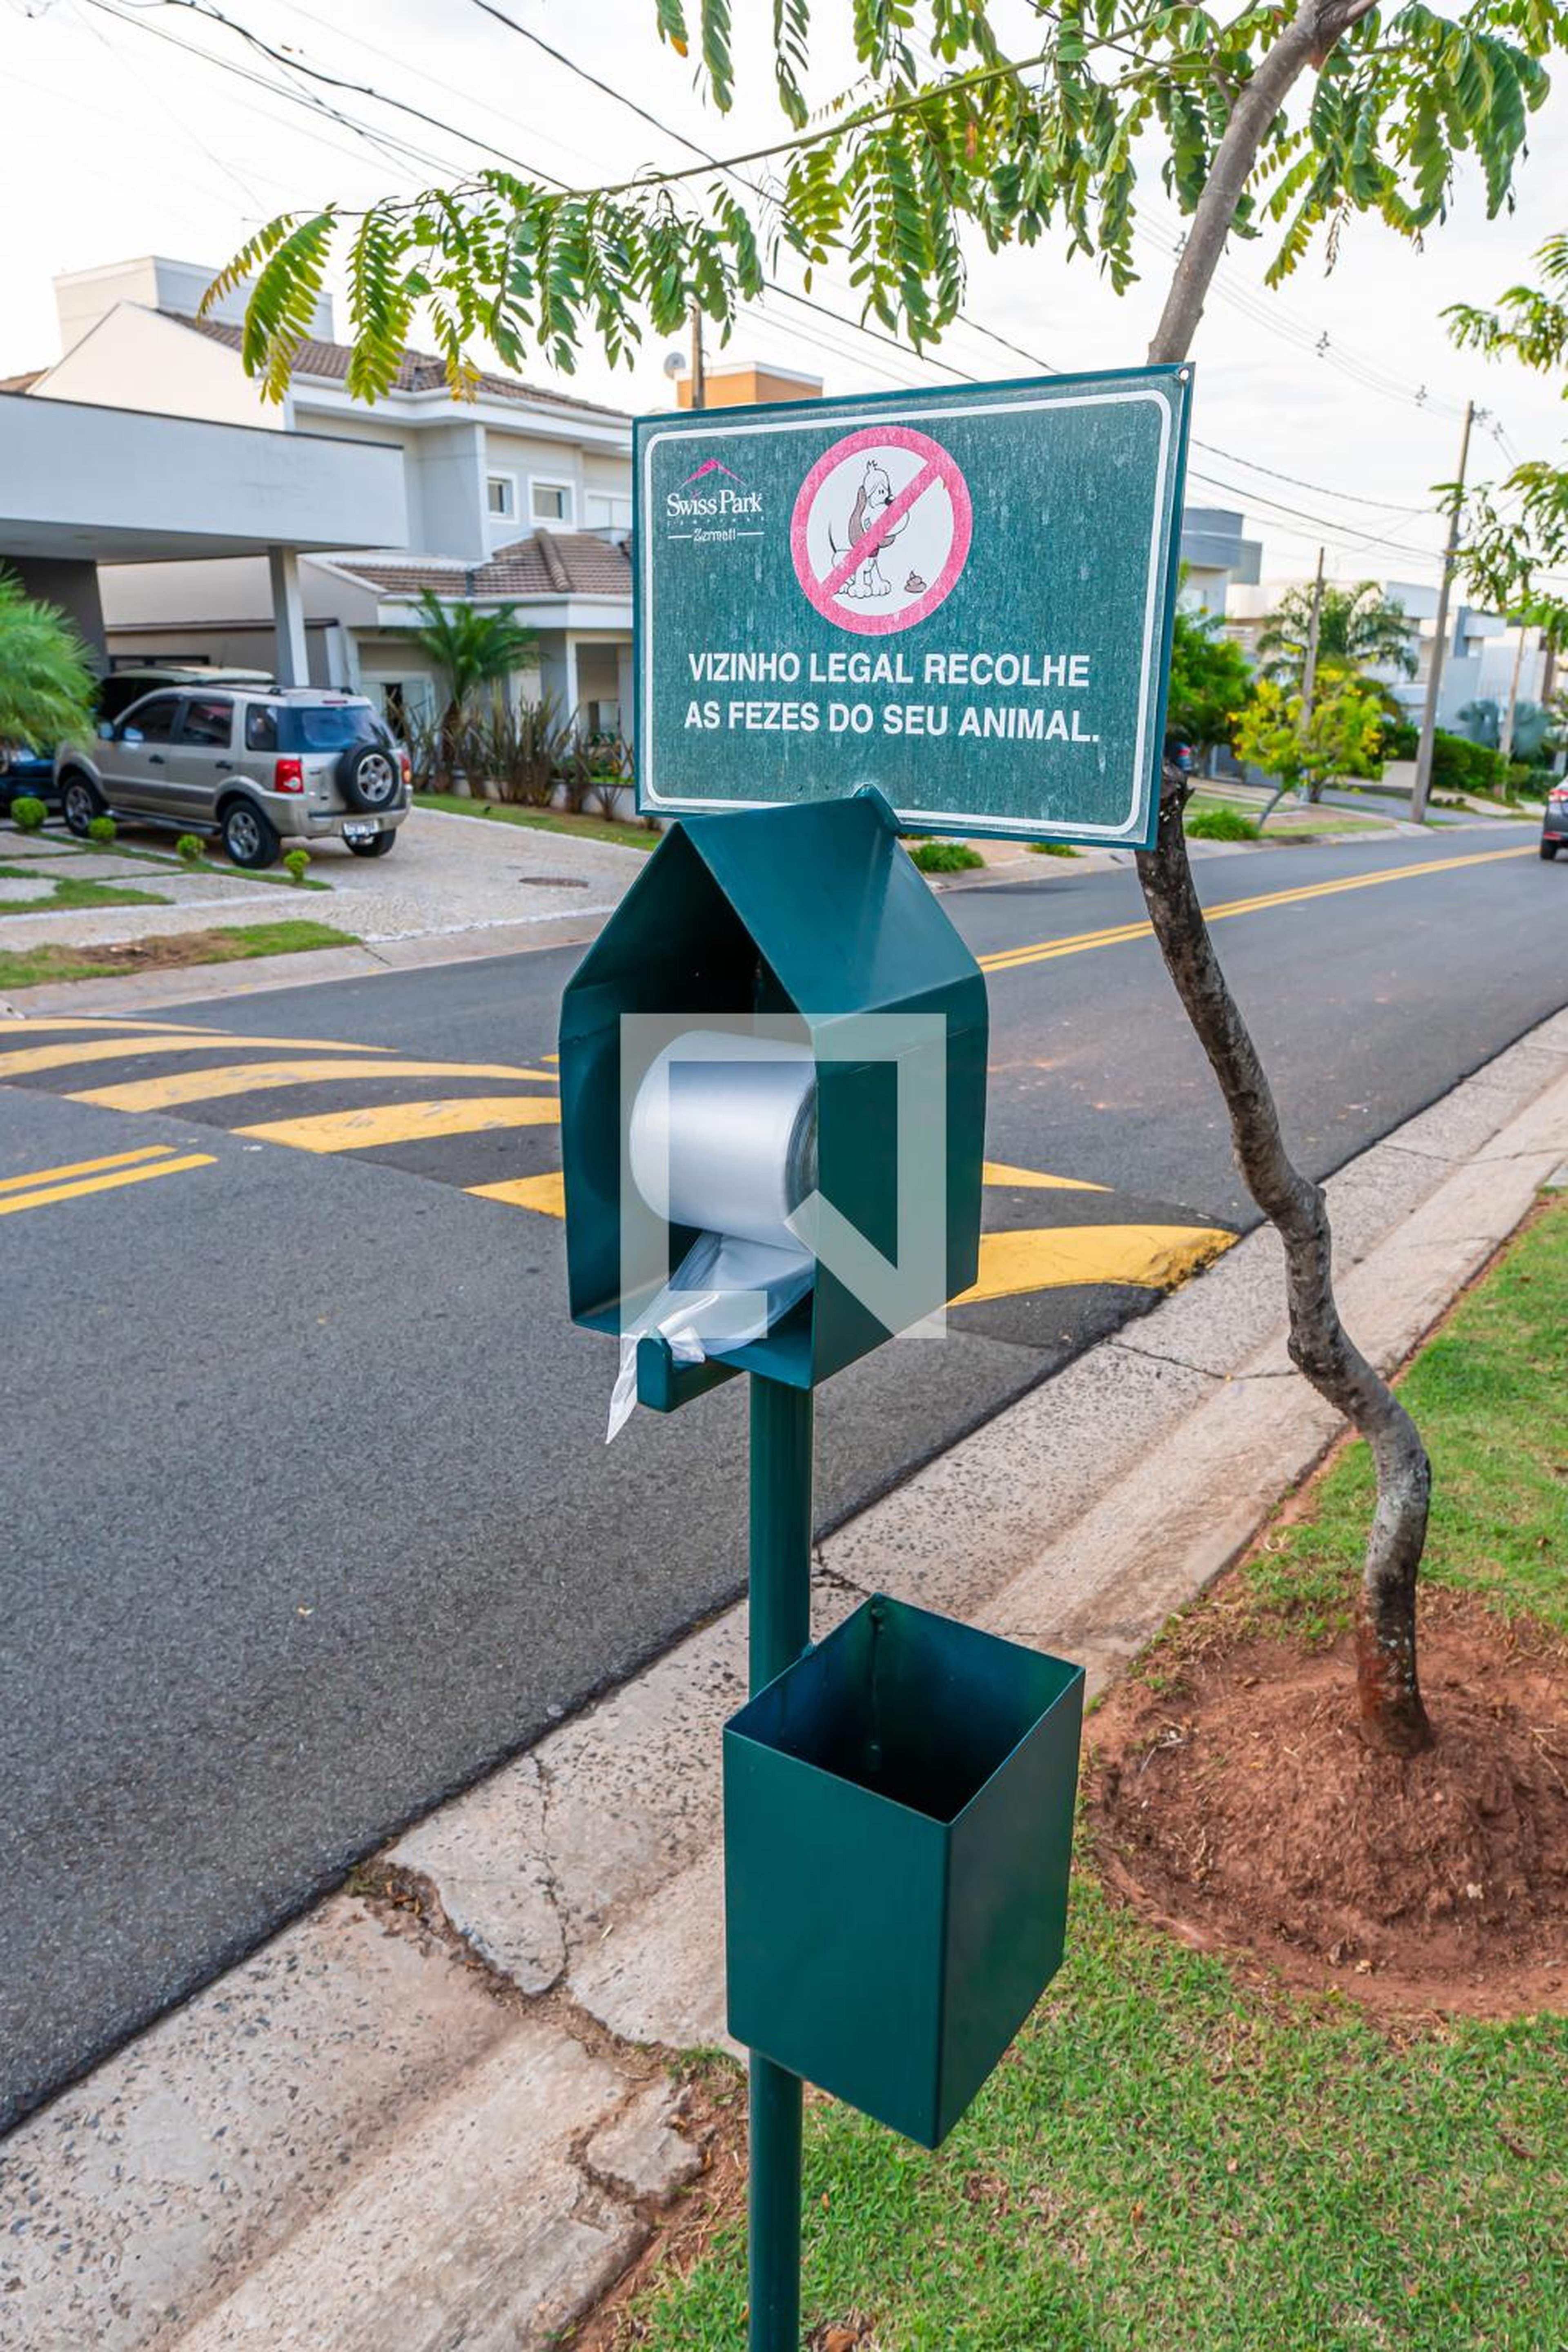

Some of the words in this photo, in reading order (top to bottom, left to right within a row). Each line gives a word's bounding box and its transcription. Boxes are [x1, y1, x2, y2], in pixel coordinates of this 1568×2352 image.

[688, 653, 800, 682] VIZINHO
[810, 653, 913, 684] LEGAL
[924, 653, 1089, 687] RECOLHE
[684, 701, 720, 729] AS
[728, 702, 820, 731] FEZES
[829, 703, 873, 733] DO
[883, 704, 948, 735] SEU
[958, 707, 1099, 742] ANIMAL.
